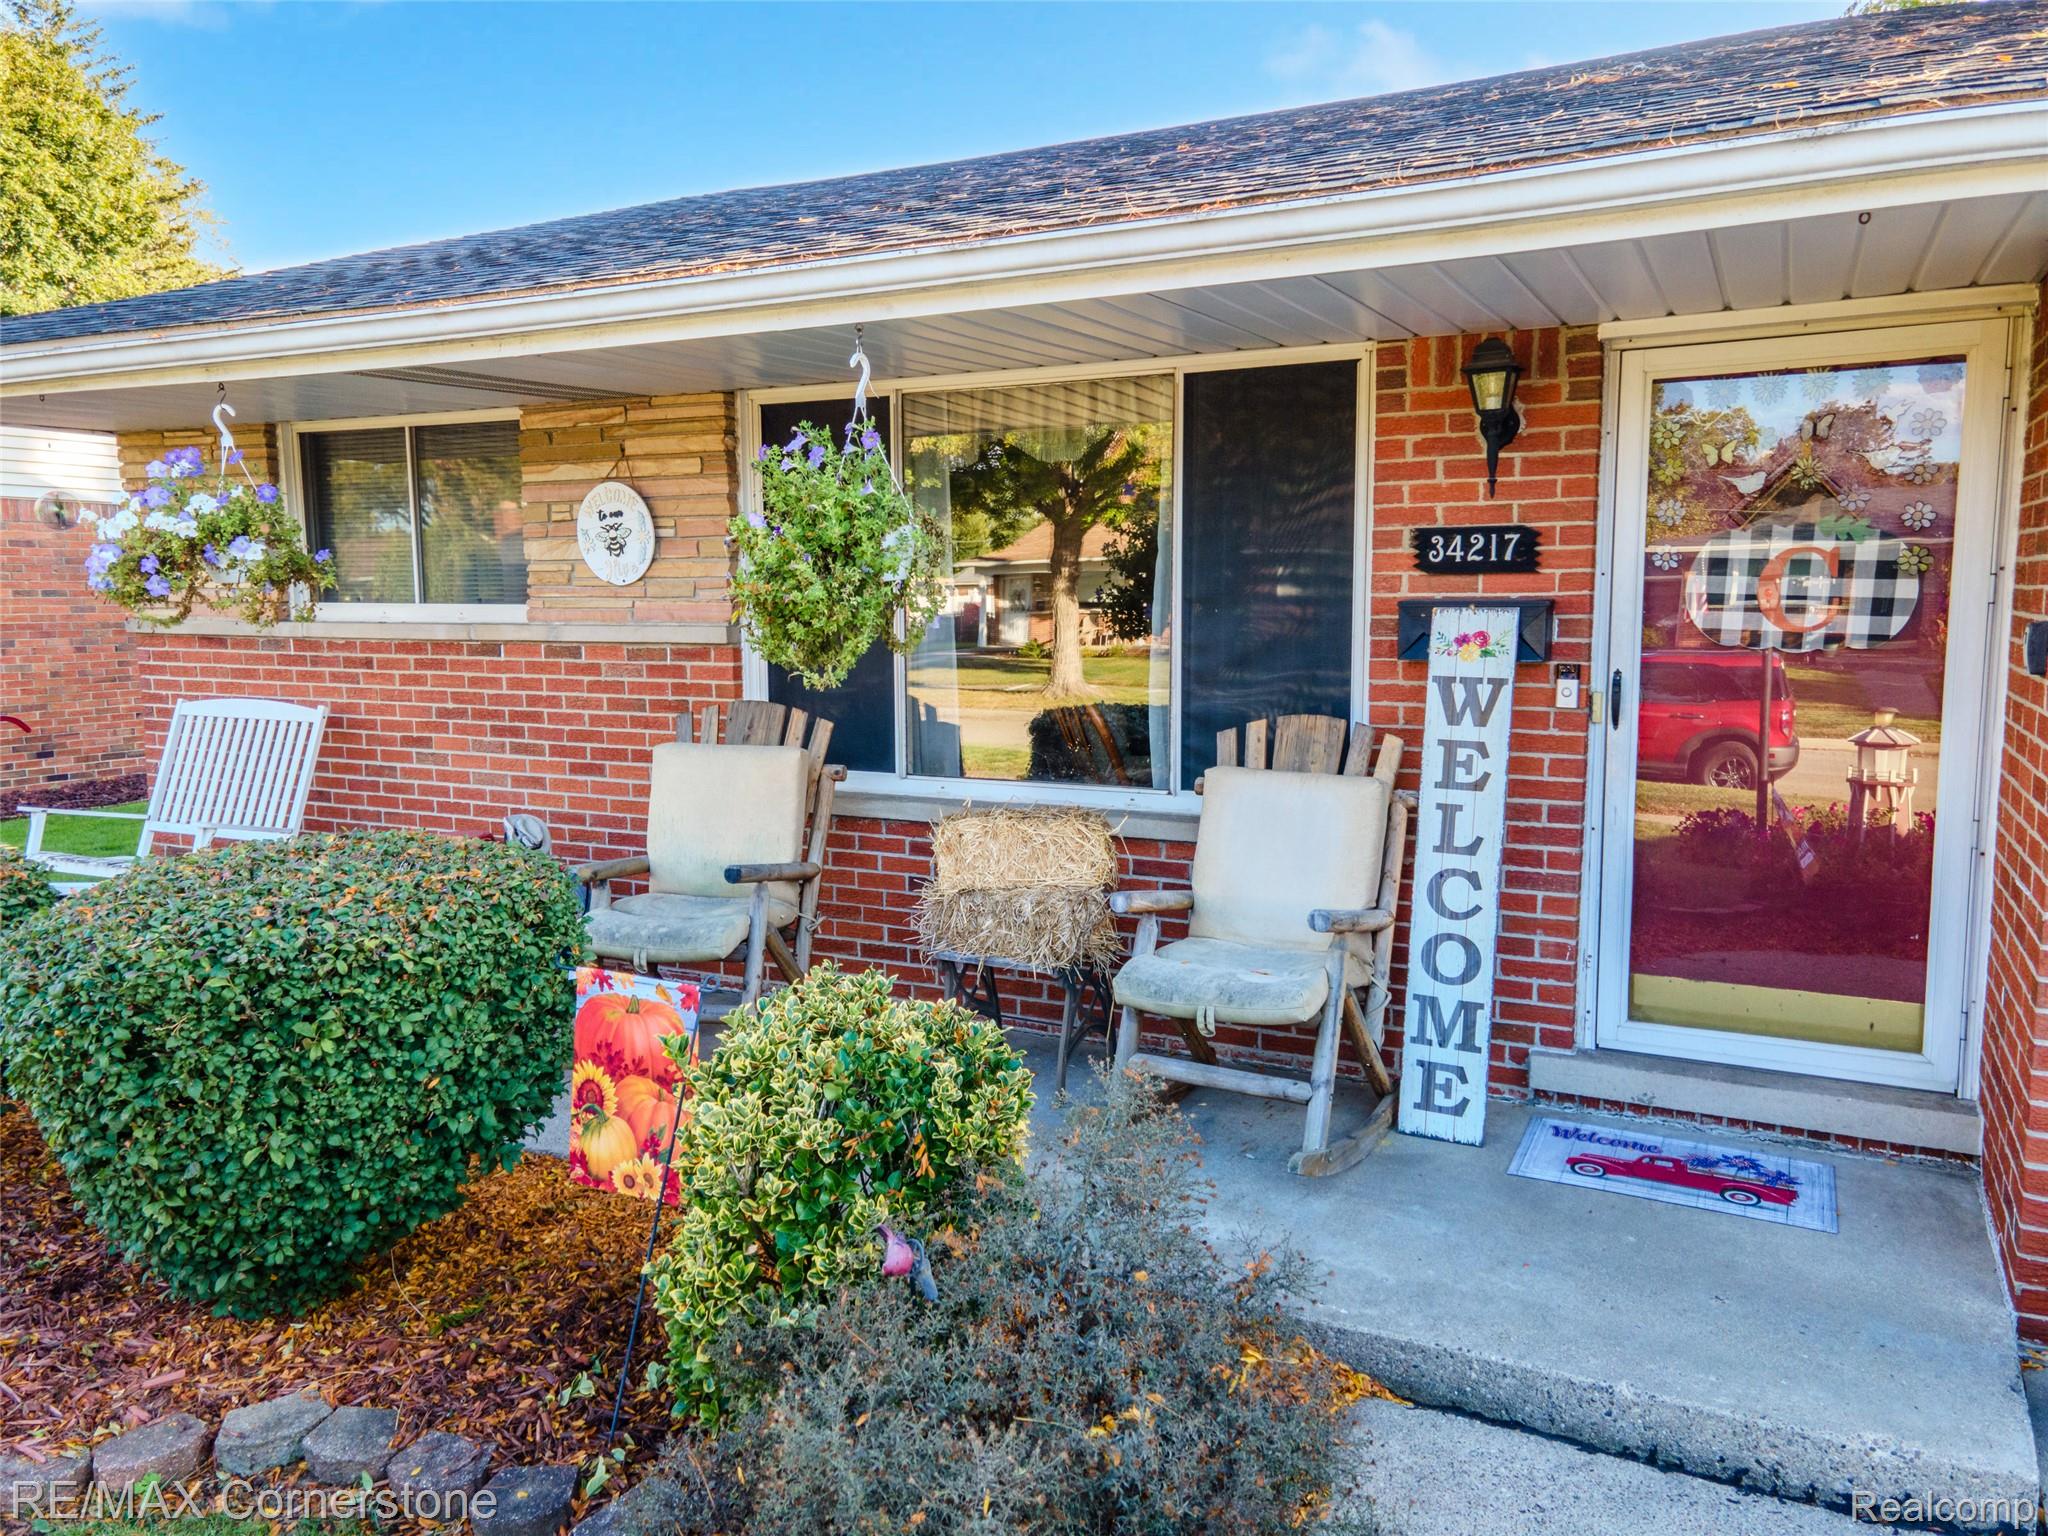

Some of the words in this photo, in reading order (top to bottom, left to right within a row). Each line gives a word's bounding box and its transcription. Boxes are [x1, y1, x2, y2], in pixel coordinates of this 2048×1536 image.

[1428, 533, 1521, 562] 34217
[1757, 546, 1840, 632] C
[1409, 675, 1509, 1118] WELCOME
[1551, 1125, 1663, 1154] Welcome
